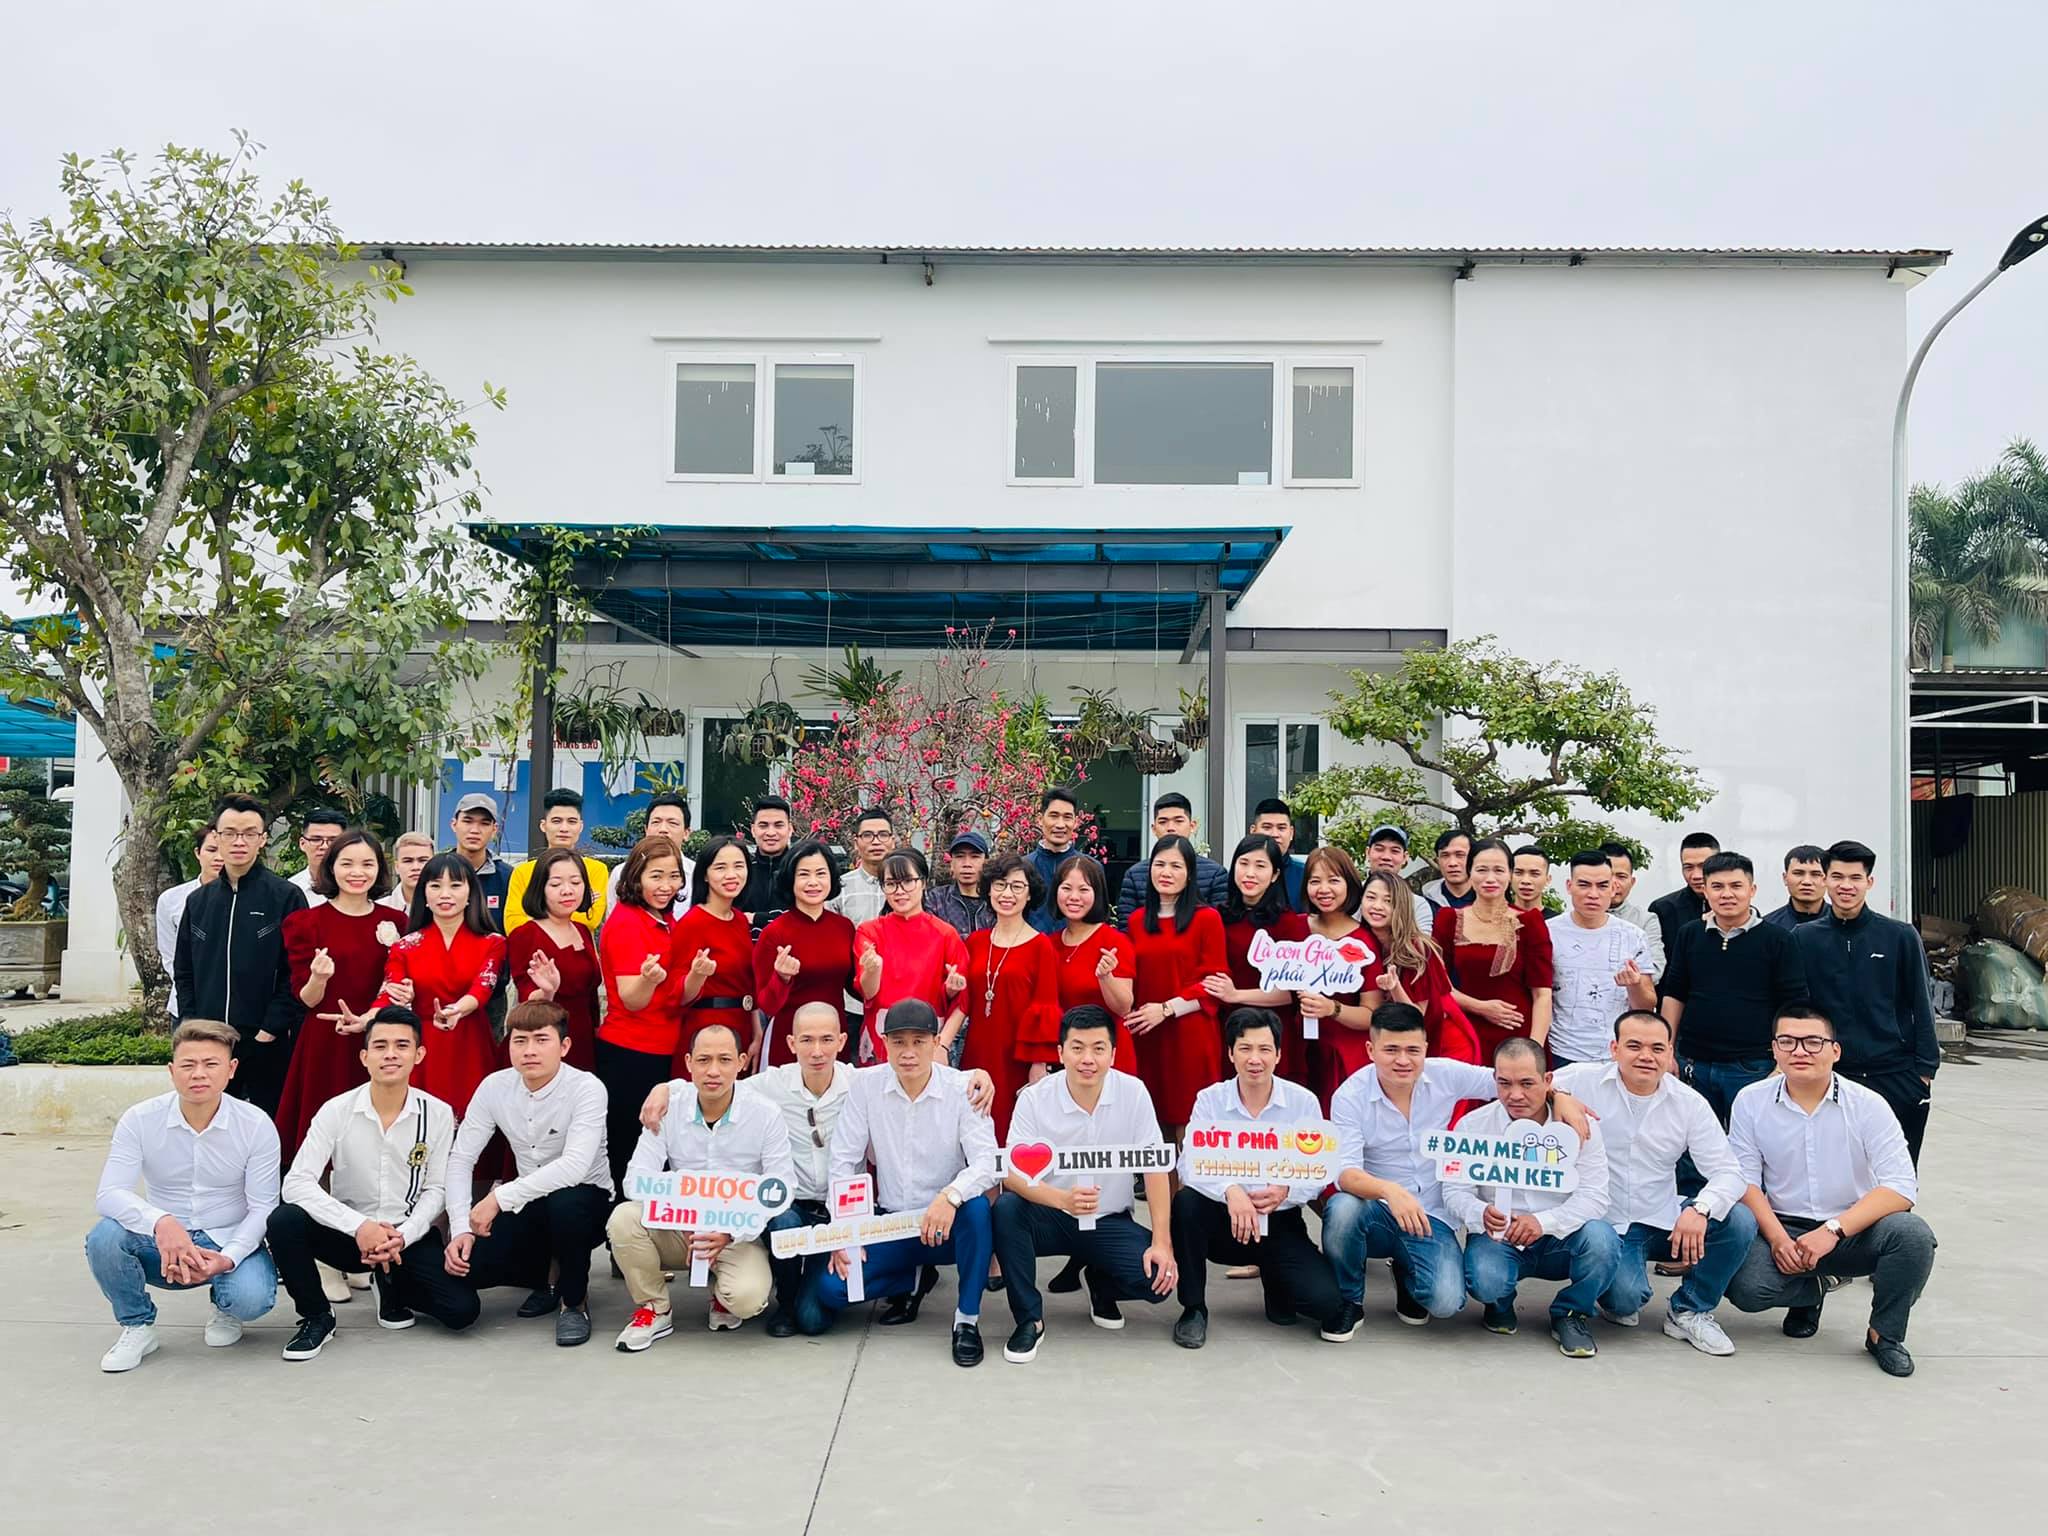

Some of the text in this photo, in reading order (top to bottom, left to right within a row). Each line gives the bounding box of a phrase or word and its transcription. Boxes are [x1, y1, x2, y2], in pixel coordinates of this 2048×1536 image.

[1253, 936, 1335, 967] Là con Gái
[1309, 962, 1356, 987] Xinh
[1193, 1126, 1278, 1150] BỨT PHÁ
[1444, 1136, 1489, 1157] ĐAM
[1058, 1150, 1112, 1170] LINH
[1195, 1156, 1327, 1180] THÀNH CÔNG
[636, 1175, 756, 1203] Nói ĐƯỢC
[649, 1200, 758, 1230] Làm ĐƯỢC
